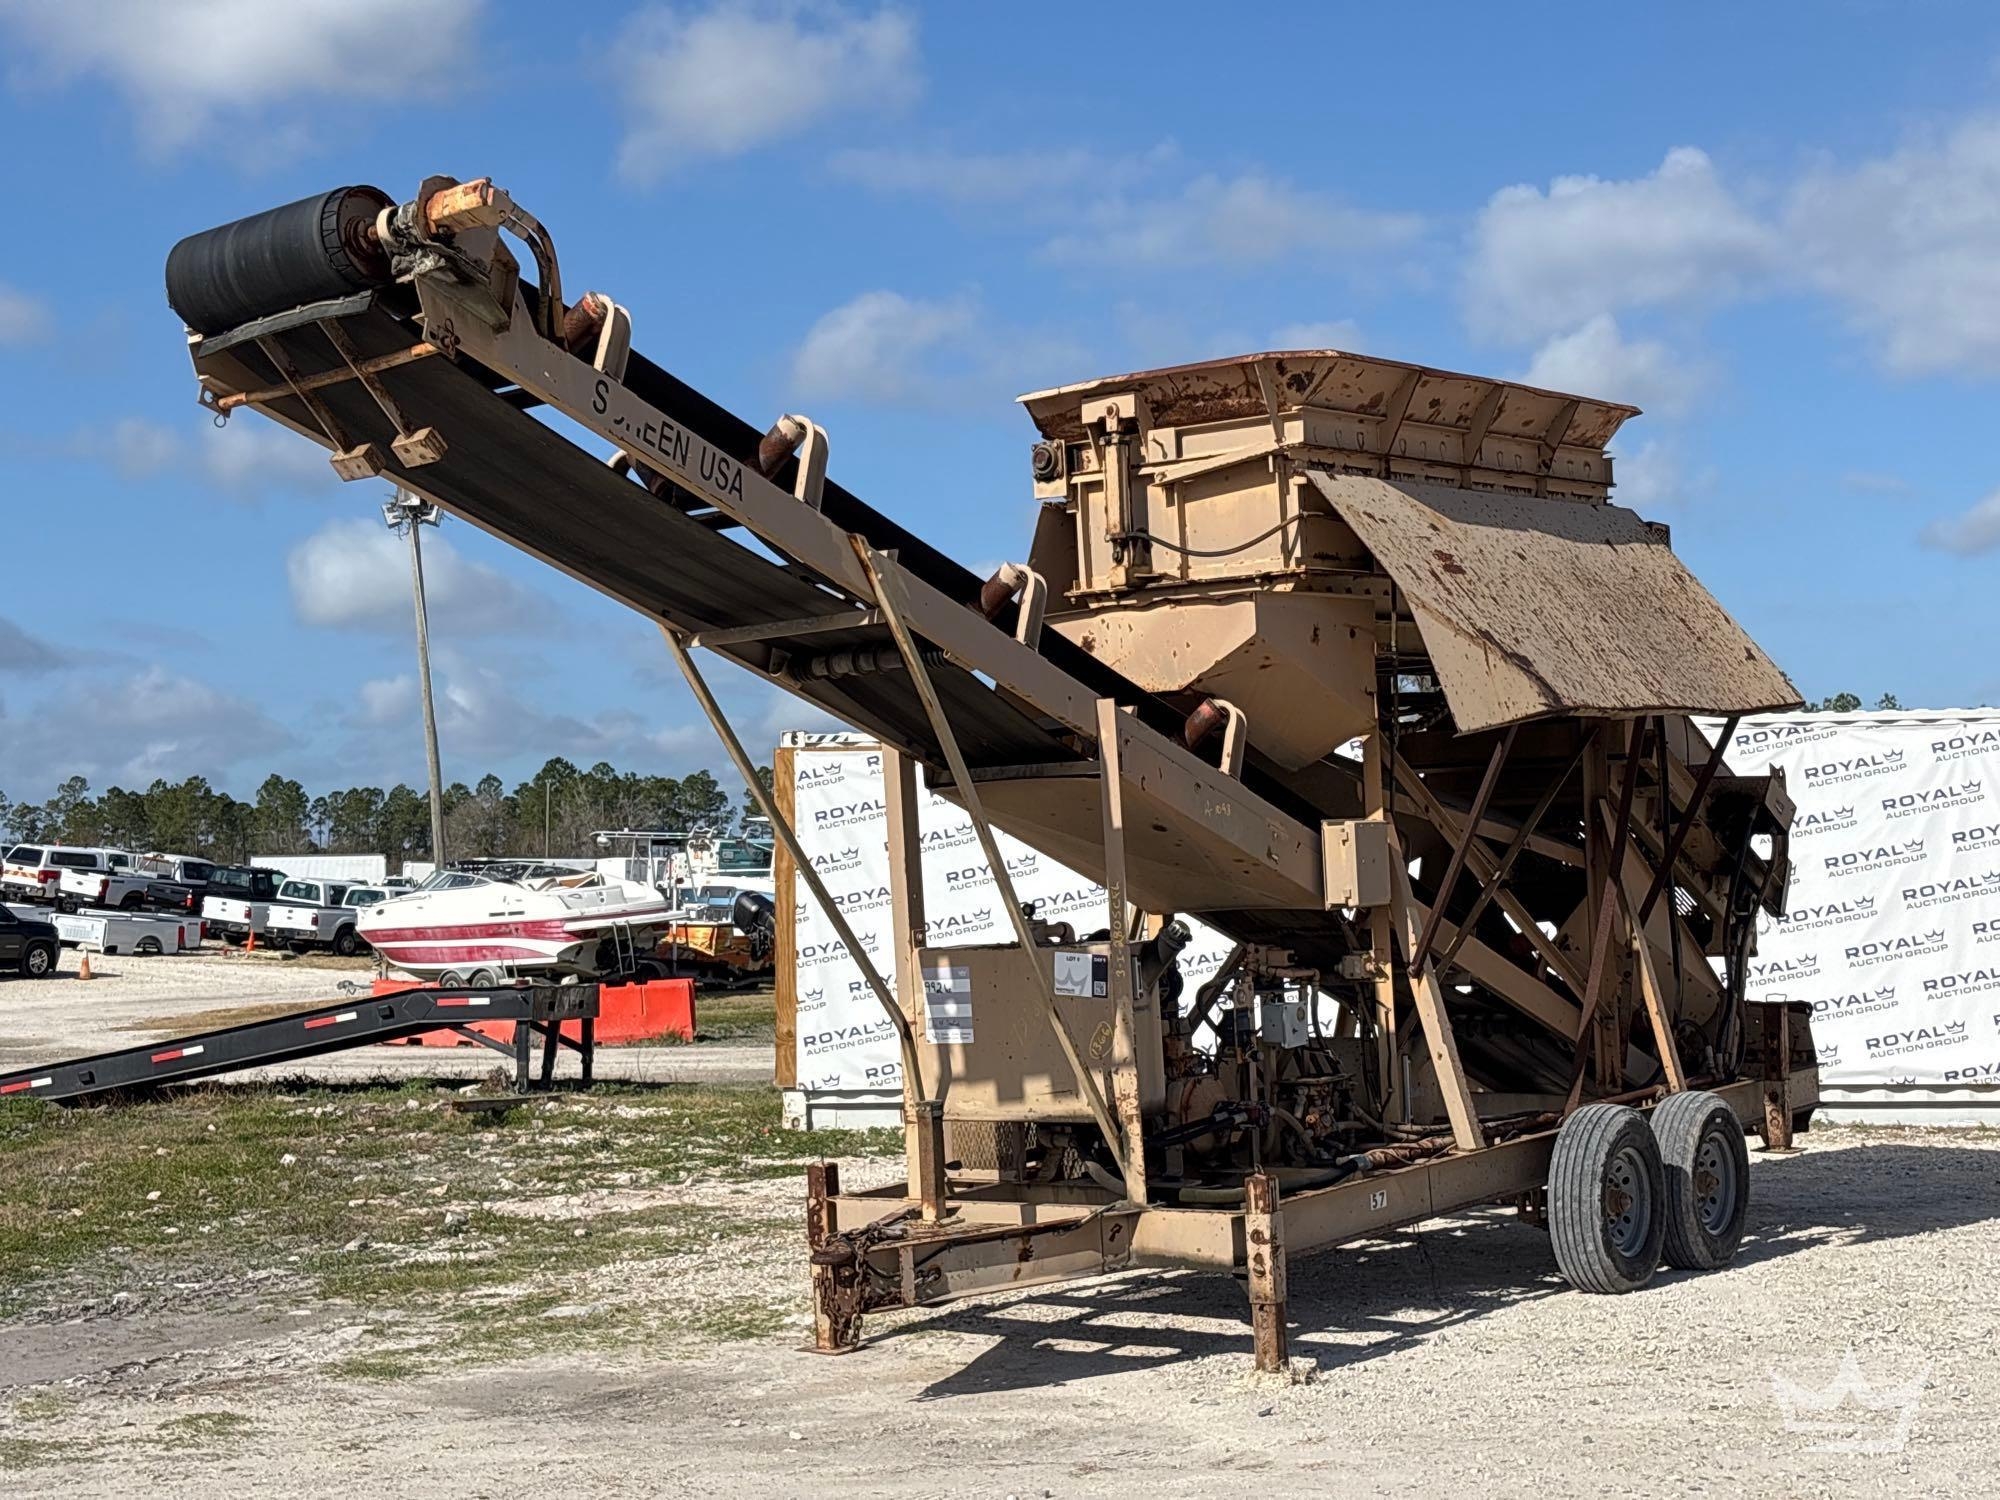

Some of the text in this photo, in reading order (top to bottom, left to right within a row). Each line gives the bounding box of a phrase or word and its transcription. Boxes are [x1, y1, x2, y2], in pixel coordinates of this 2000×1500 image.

[700, 446, 743, 501] USA
[1740, 731, 1838, 756] AUCTION GROUP
[1936, 746, 1989, 763] AUCTION
[1805, 755, 1883, 779] ROYAL
[1808, 763, 1907, 788] AUCTION GROUP
[807, 776, 845, 789] GROUP
[1882, 786, 1962, 811] ROYAL
[1886, 794, 1985, 820] AUCTION GROUP
[815, 800, 886, 822] ROYAL
[818, 815, 866, 831] AUCTION
[1815, 820, 1858, 834] GROUP
[938, 836, 976, 849] GROUP
[1952, 824, 2000, 844] ROY
[1956, 839, 2000, 854] AUCTIO
[824, 861, 862, 874] GROUP
[1824, 846, 1904, 869] ROYAL
[1828, 854, 1927, 878] AUCTION GROUP
[1008, 868, 1039, 878] ROUP
[831, 887, 891, 906] ROYA
[1902, 877, 1982, 901] ROYAL
[842, 902, 883, 914] UCTION
[1071, 898, 1109, 911] GROUP
[1906, 894, 1960, 910] AUCTION
[1776, 902, 1854, 925] ROYAL
[1780, 910, 1878, 934] AUCTION GROUP
[956, 922, 994, 935] GROUP
[1845, 936, 1924, 959] ROYAL
[1848, 944, 1948, 968] AUCTION GROUP
[797, 955, 838, 968] UCTION
[1779, 968, 1820, 982] GROUP
[1923, 968, 2000, 992] ROYAL
[1814, 992, 1875, 1012] OYAL
[1927, 984, 1981, 1001] AUCTION
[1856, 1001, 1899, 1014] GROUP
[803, 1024, 875, 1048] ROYAL
[806, 1032, 896, 1056] AUCTION GROUP
[1866, 1026, 1946, 1050] ROYAL
[1870, 1035, 1970, 1060] AUCTION GROUP
[1372, 1191, 1385, 1209] 57
